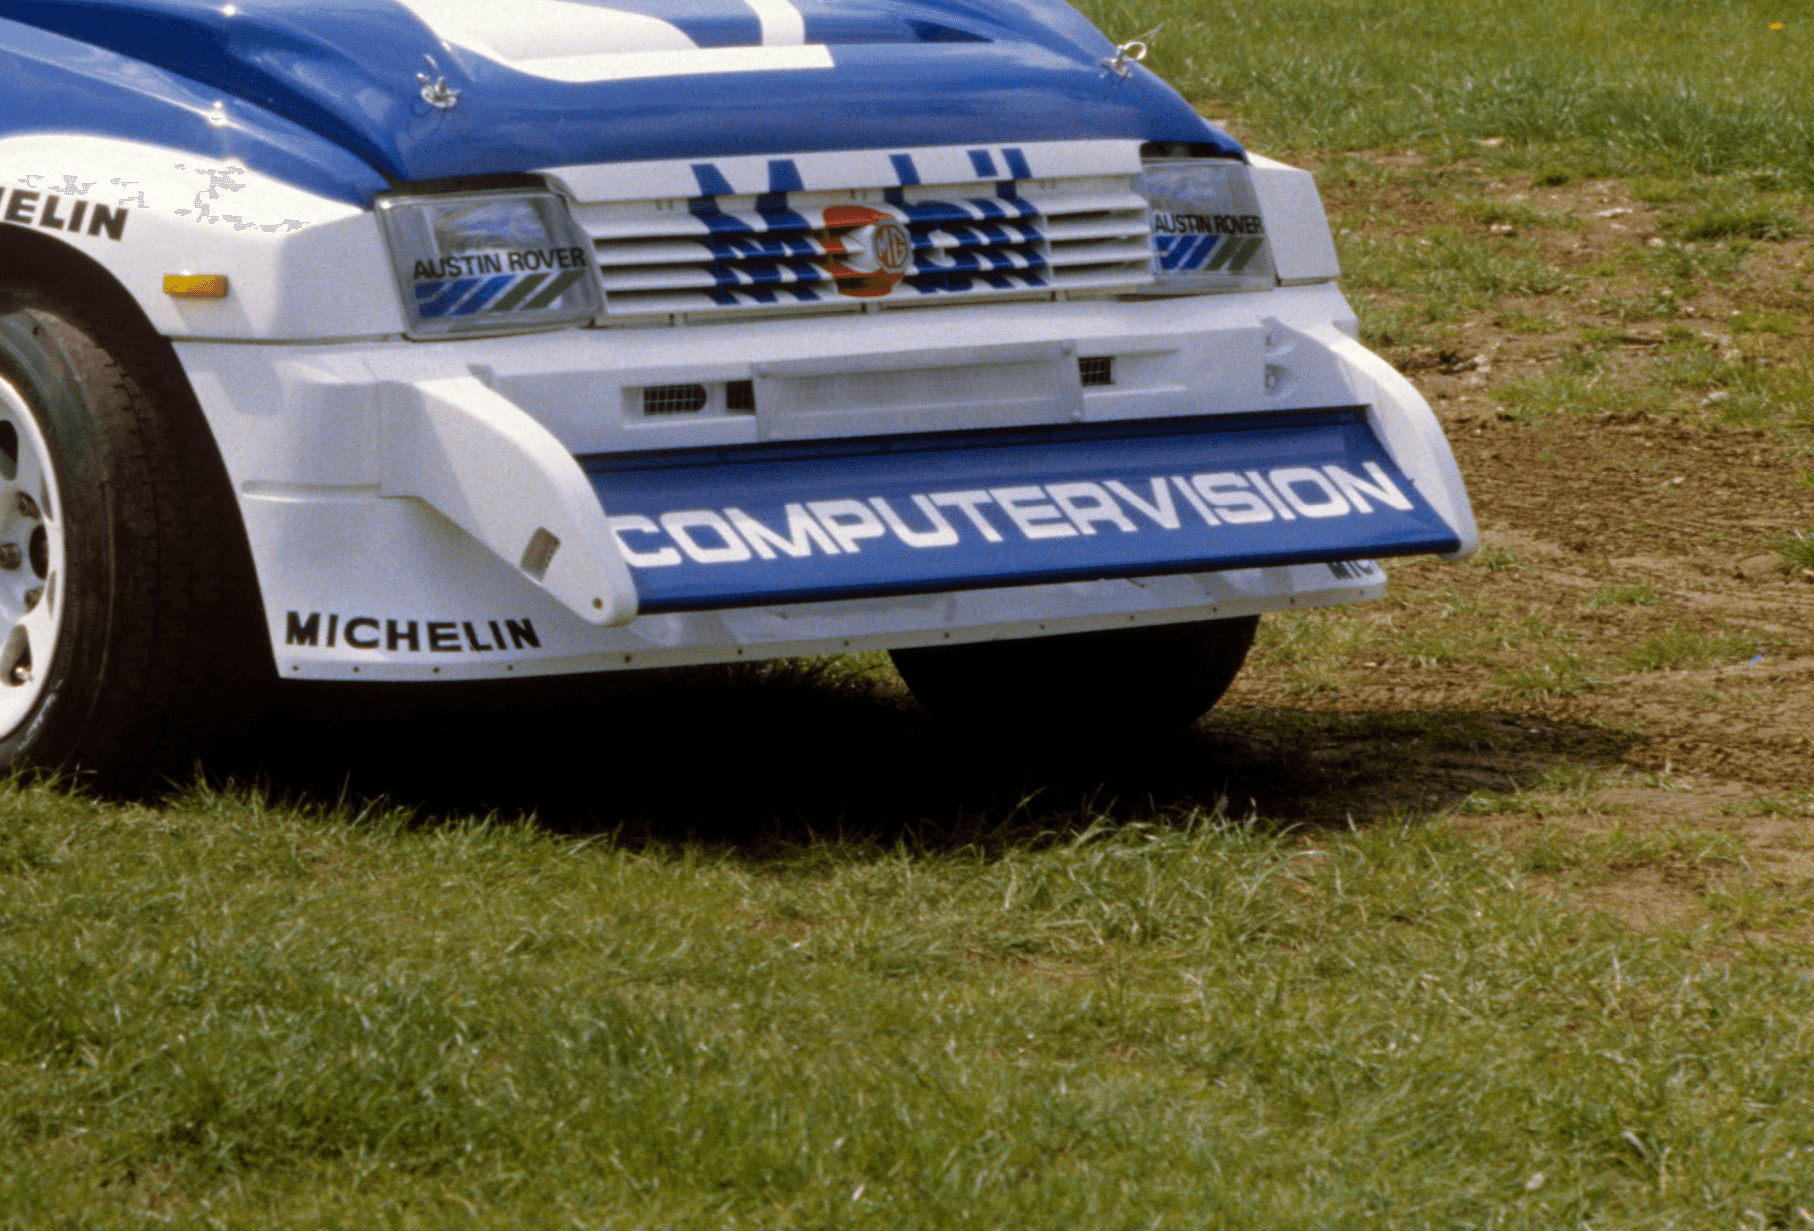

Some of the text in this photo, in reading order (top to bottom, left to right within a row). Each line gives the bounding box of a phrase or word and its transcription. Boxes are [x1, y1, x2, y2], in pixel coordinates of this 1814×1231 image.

[1154, 214, 1265, 235] AUSTIN ROVER
[414, 247, 587, 280] AUSTIN ROVER
[606, 460, 1415, 568] COMPUTERVISION
[286, 611, 541, 652] MICHELIN
